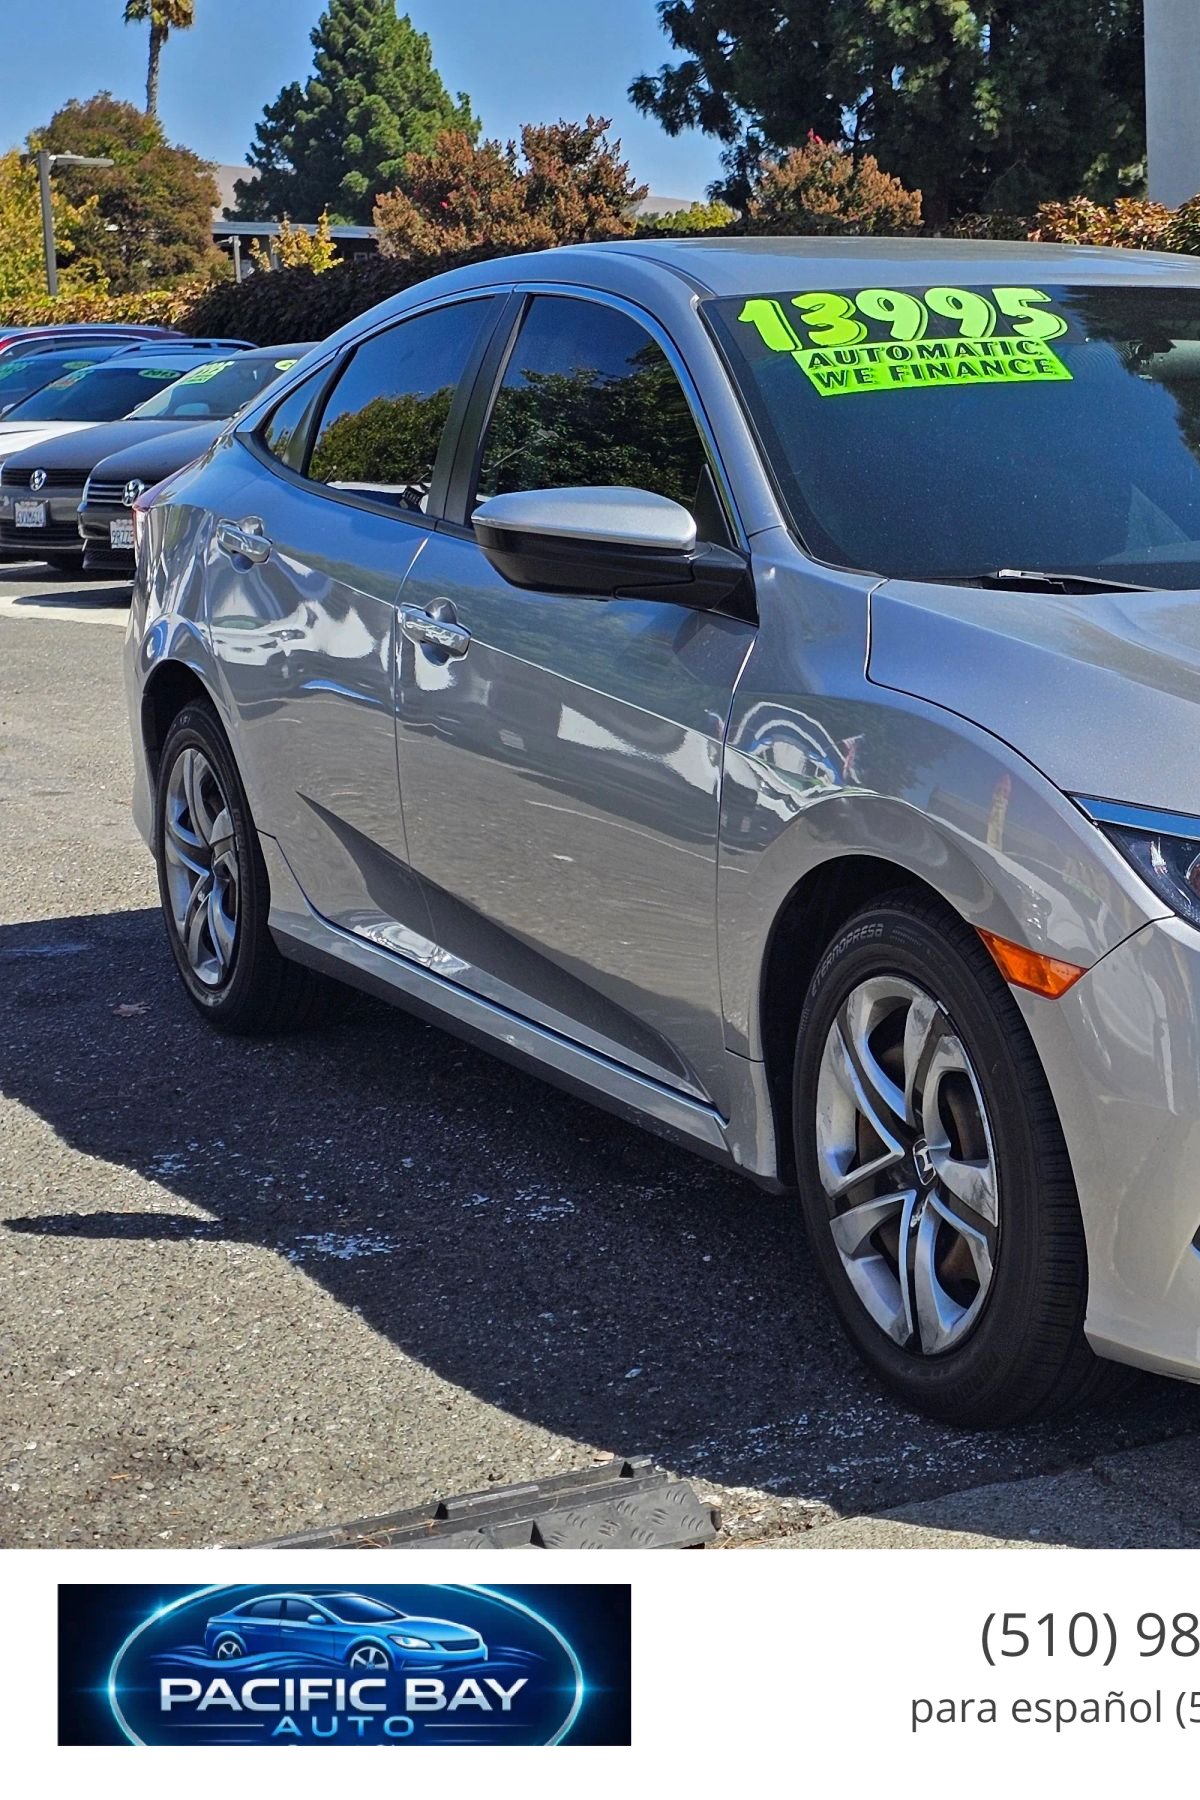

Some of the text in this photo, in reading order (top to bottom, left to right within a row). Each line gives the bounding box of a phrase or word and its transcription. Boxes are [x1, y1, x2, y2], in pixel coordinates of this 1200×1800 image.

[738, 287, 1068, 352] 13995
[807, 339, 1045, 369] AUTOMATIC
[811, 357, 1055, 390] WE FINANCE
